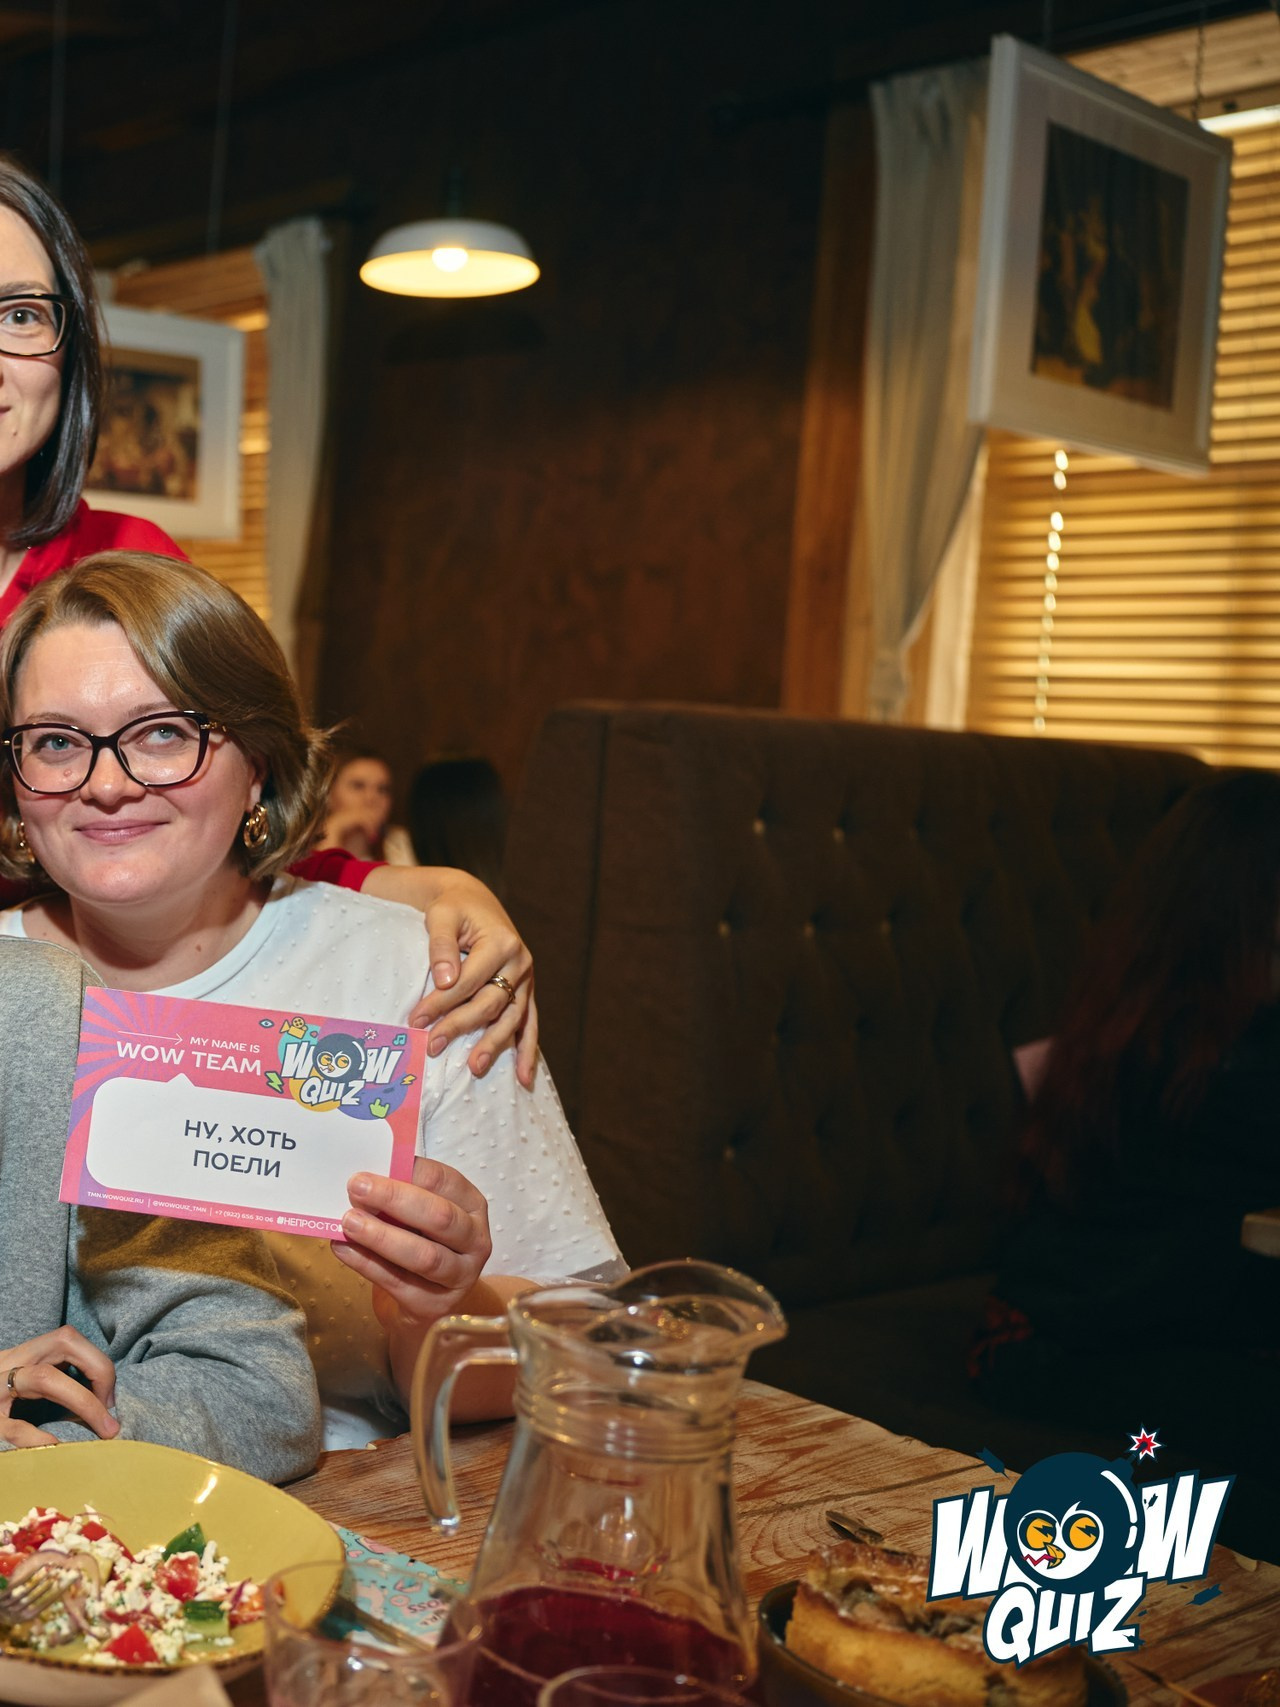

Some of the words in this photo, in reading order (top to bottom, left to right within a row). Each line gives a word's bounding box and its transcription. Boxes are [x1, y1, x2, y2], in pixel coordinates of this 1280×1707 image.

[116, 1041, 185, 1065] WOW
[191, 1051, 262, 1076] TEAM
[189, 1036, 209, 1047] MY
[211, 1039, 248, 1052] NAME
[249, 1044, 261, 1053] IS
[299, 1076, 367, 1106] QUIZ
[184, 1119, 222, 1143] НУ,
[229, 1125, 297, 1151] ХОТЬ
[193, 1149, 281, 1178] ПОЕЛИ
[87, 1191, 145, 1205] TMN.WOWQUIZ.RU
[152, 1200, 208, 1213] @WOWQUIZ_TMN
